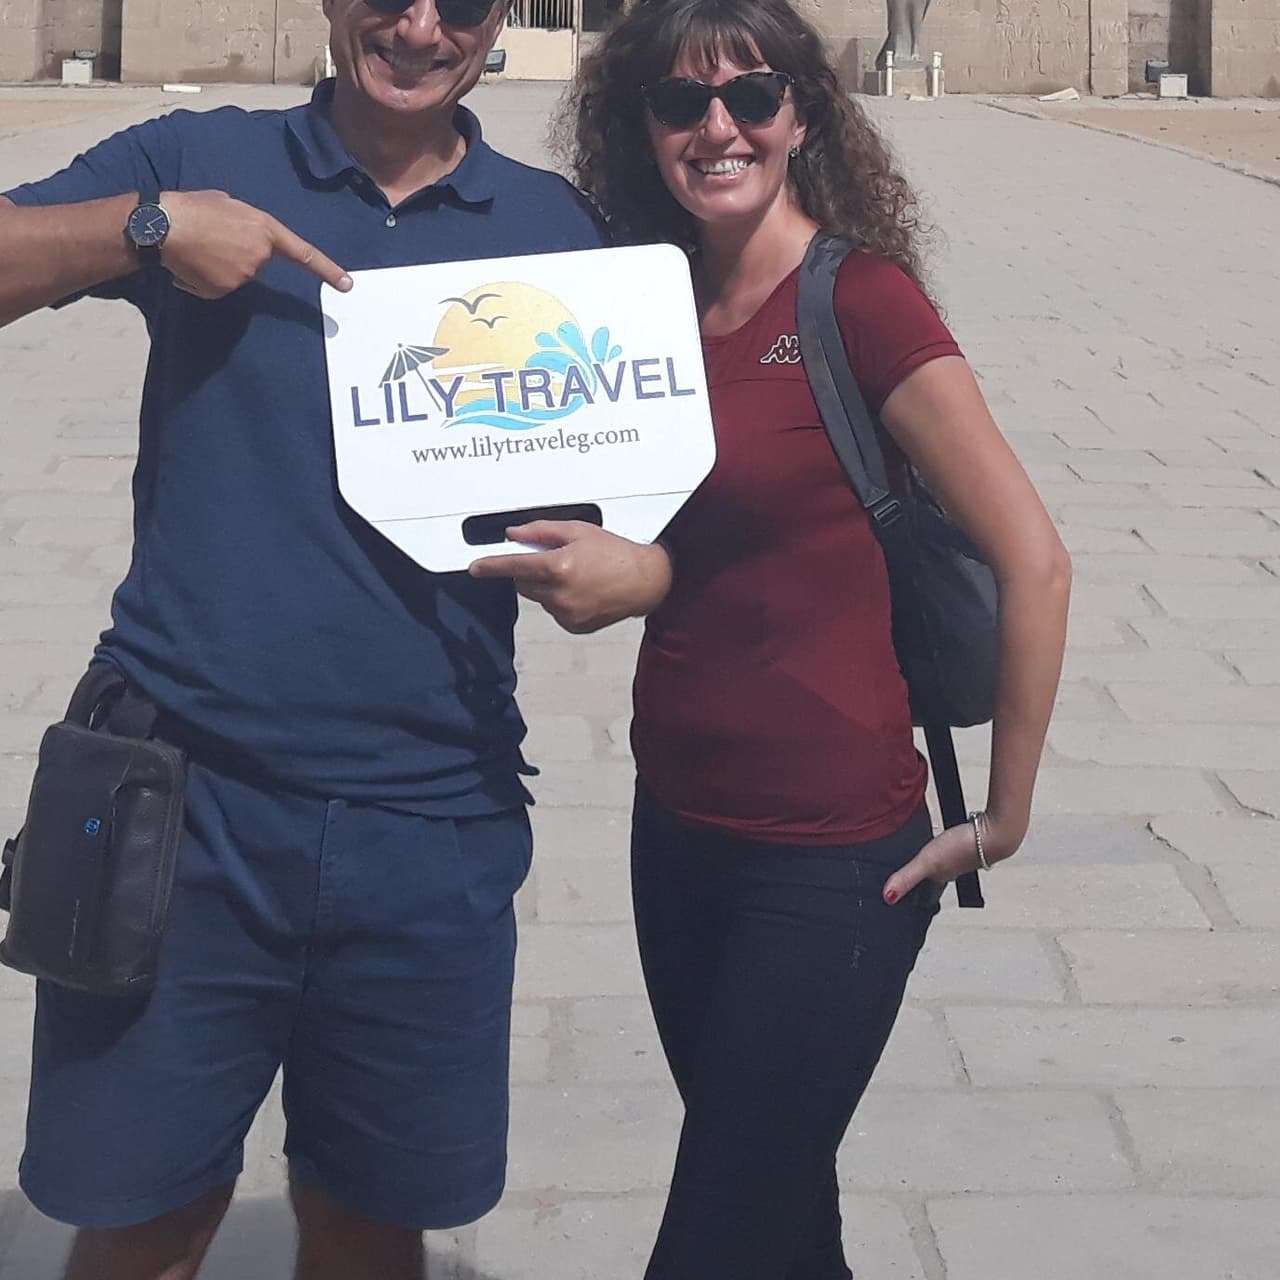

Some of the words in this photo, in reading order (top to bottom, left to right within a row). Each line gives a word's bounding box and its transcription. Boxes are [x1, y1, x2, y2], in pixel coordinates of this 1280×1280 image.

[350, 375, 464, 427] LILY
[481, 356, 697, 413] TRAVEL
[411, 426, 641, 464] www.lilytraveleg.com
